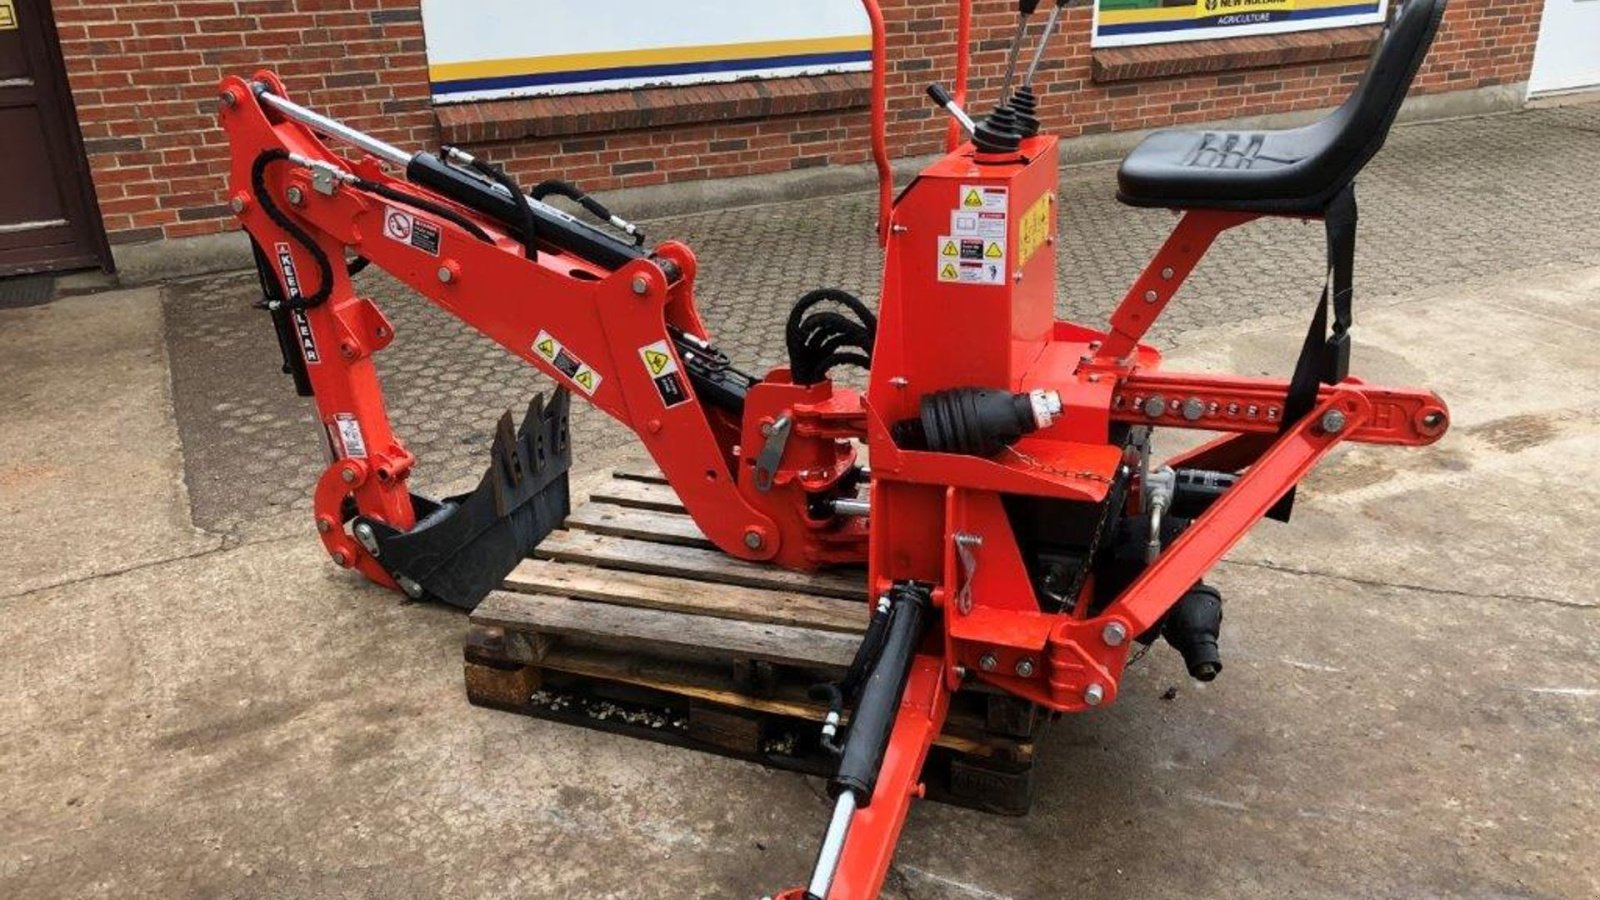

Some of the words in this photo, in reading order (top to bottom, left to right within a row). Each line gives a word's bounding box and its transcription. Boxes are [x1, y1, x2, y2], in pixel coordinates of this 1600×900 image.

[1217, 12, 1270, 24] AGRICULTURE
[280, 253, 299, 298] KEEP
[294, 307, 317, 360] LEAR
